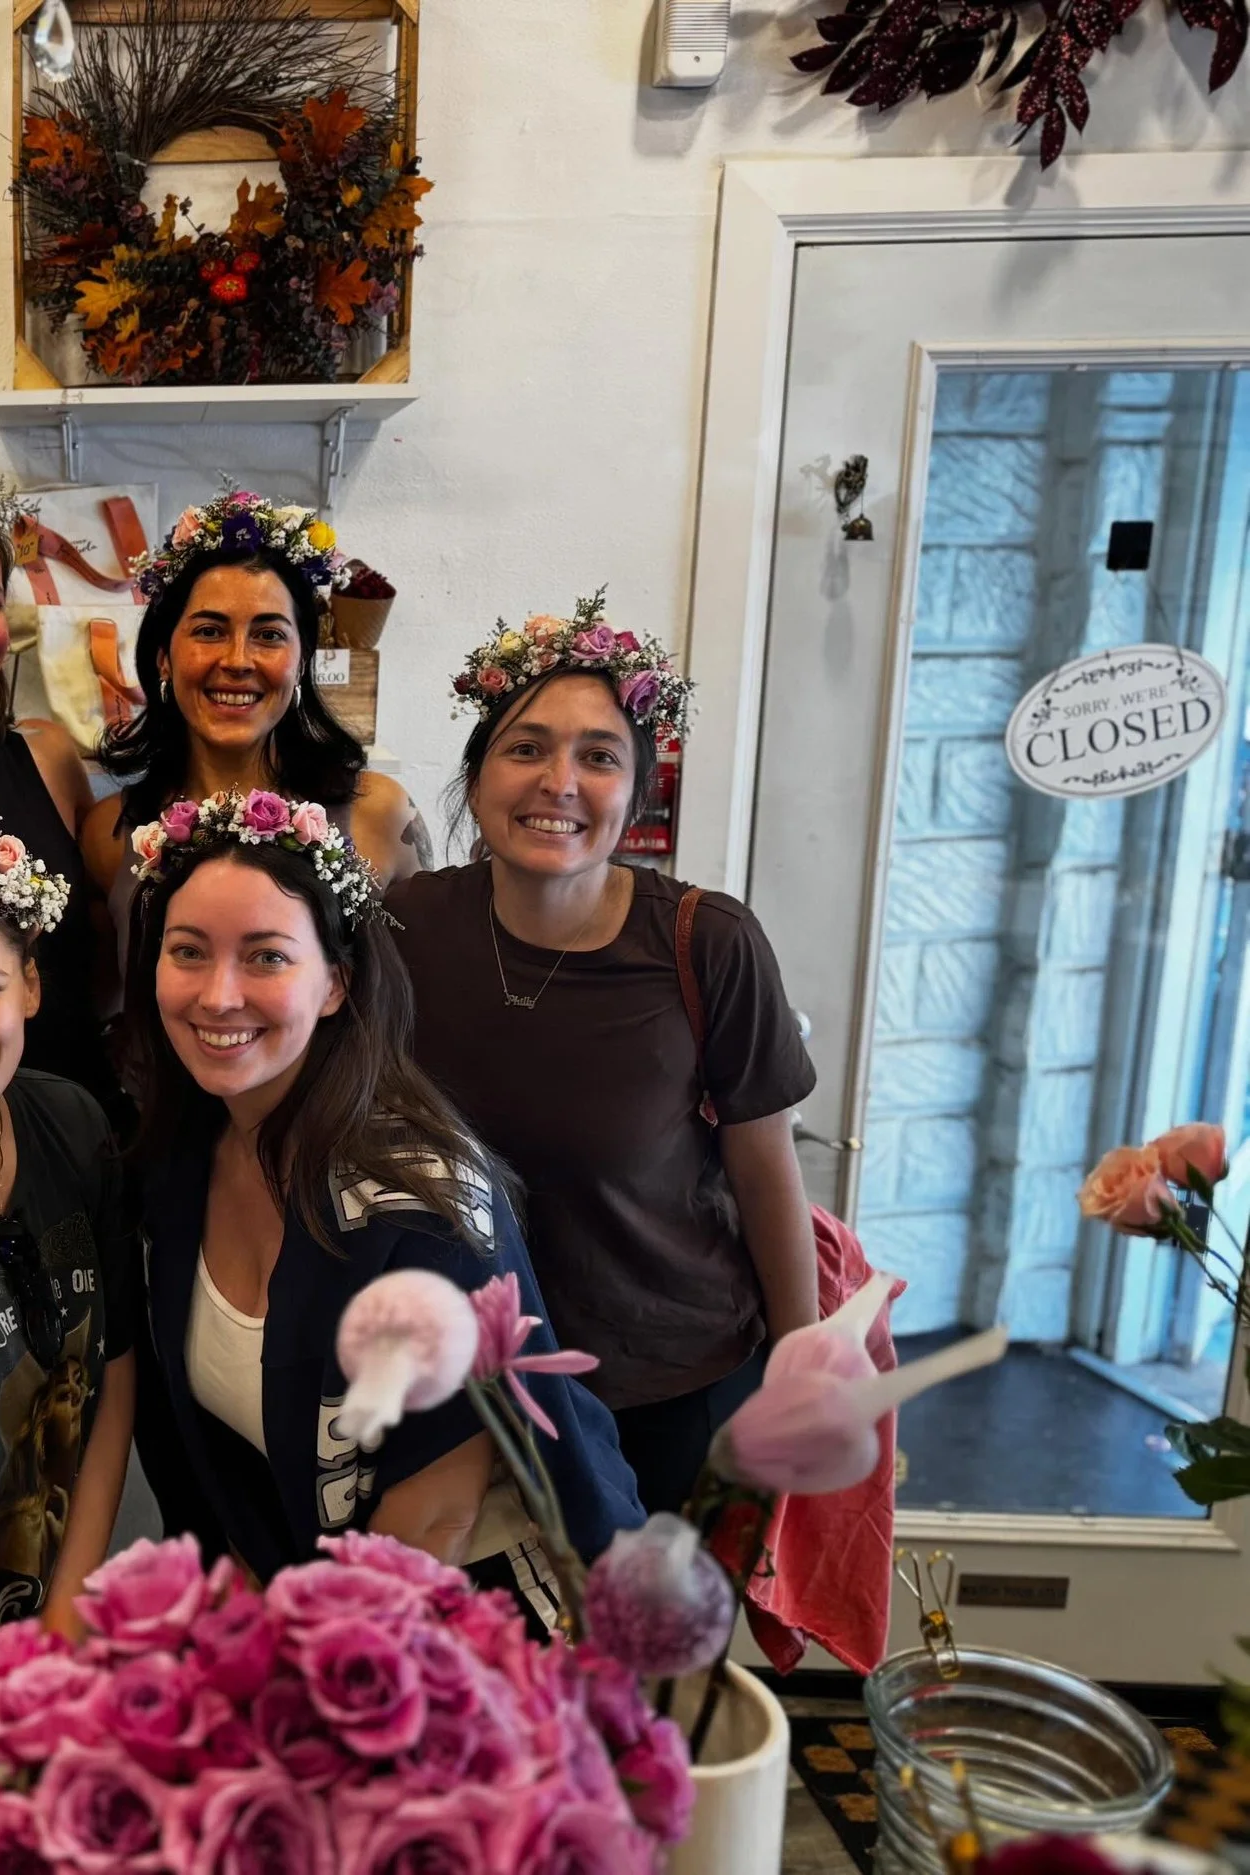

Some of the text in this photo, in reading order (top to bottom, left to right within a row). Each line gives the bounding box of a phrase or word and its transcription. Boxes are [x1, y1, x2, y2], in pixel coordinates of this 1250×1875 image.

[317, 672, 345, 683] 6.00
[1025, 697, 1211, 769] CLOSED
[505, 994, 535, 1010] Philly
